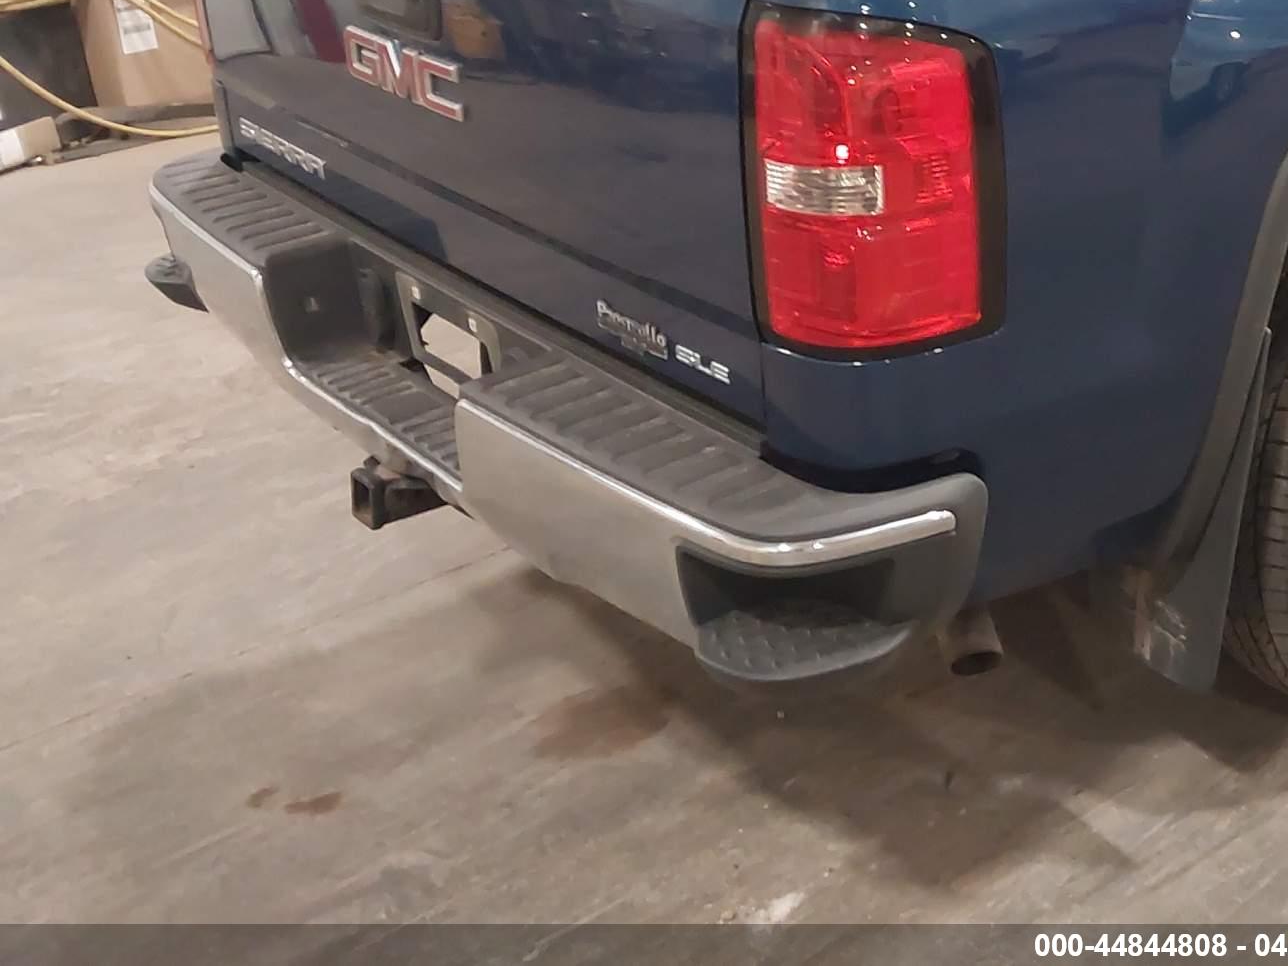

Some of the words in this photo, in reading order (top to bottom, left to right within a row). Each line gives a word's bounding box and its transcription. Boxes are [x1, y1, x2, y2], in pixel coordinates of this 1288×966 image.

[343, 25, 464, 123] GMC
[239, 116, 327, 181] SIERRA
[675, 343, 731, 385] SLE
